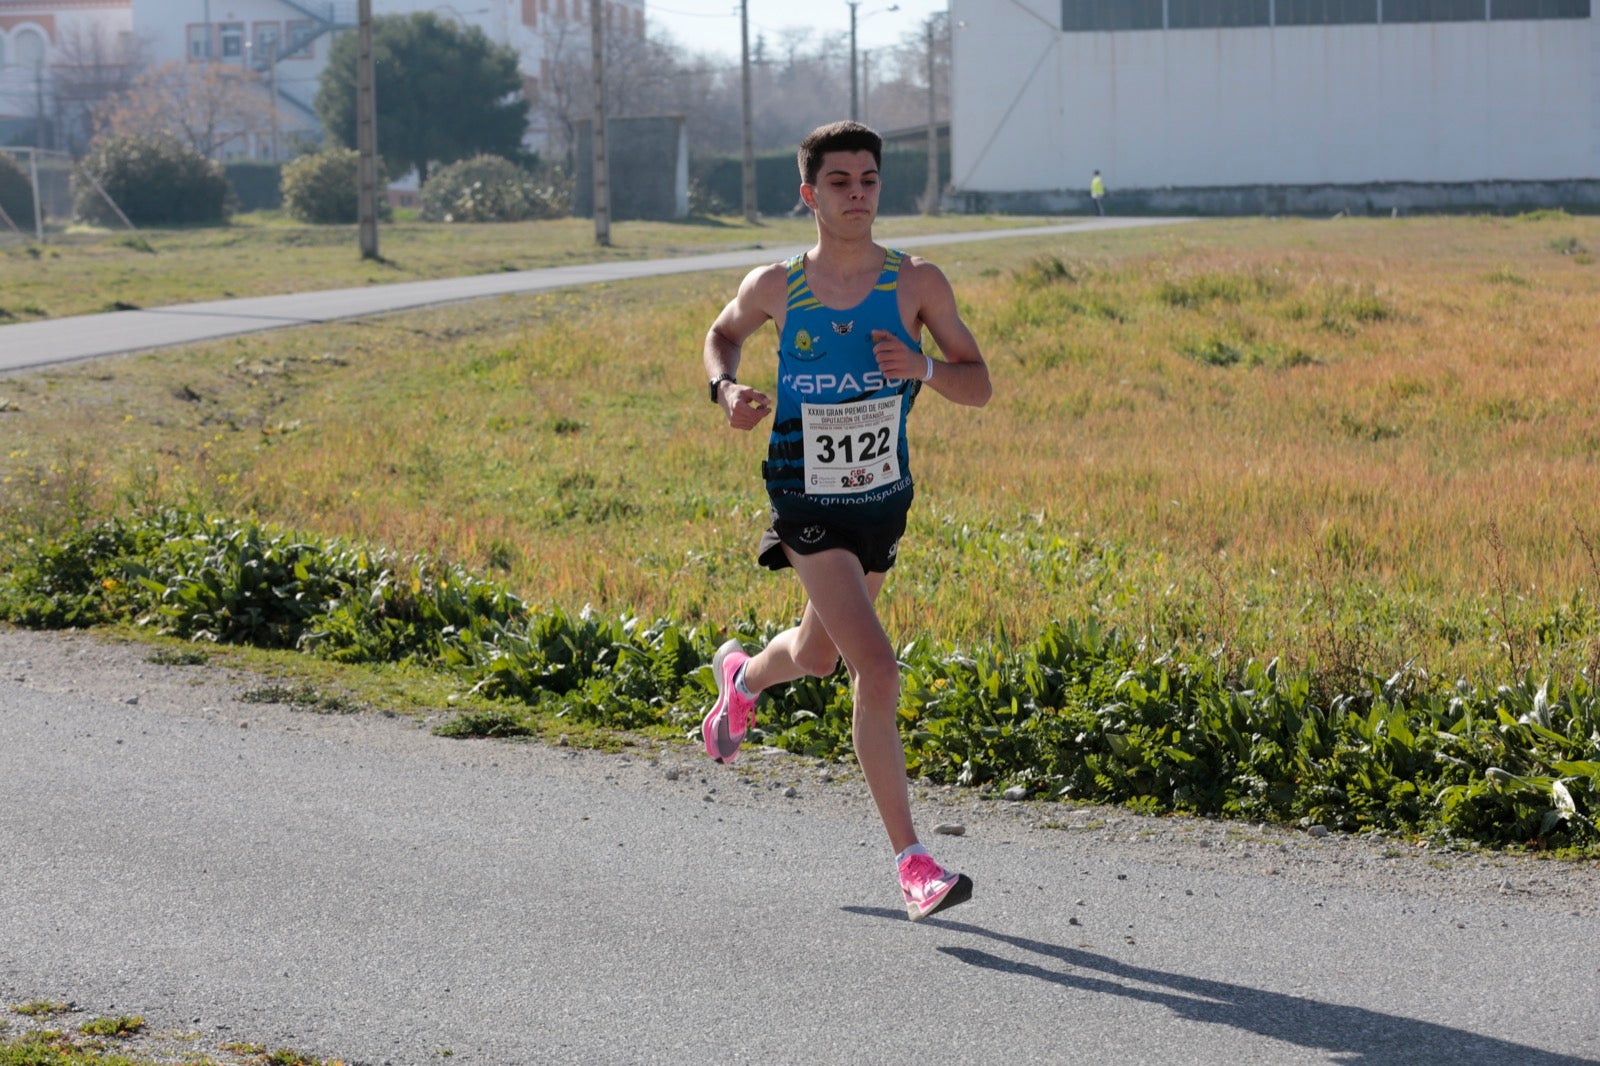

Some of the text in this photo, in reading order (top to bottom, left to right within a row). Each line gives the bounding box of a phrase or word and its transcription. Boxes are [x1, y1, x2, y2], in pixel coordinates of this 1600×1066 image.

[826, 407, 844, 417] GRAN
[845, 405, 868, 416] PREMIO
[868, 404, 877, 412] DE
[877, 400, 896, 411] FONDO
[853, 415, 861, 423] DE
[815, 426, 890, 464] 3122
